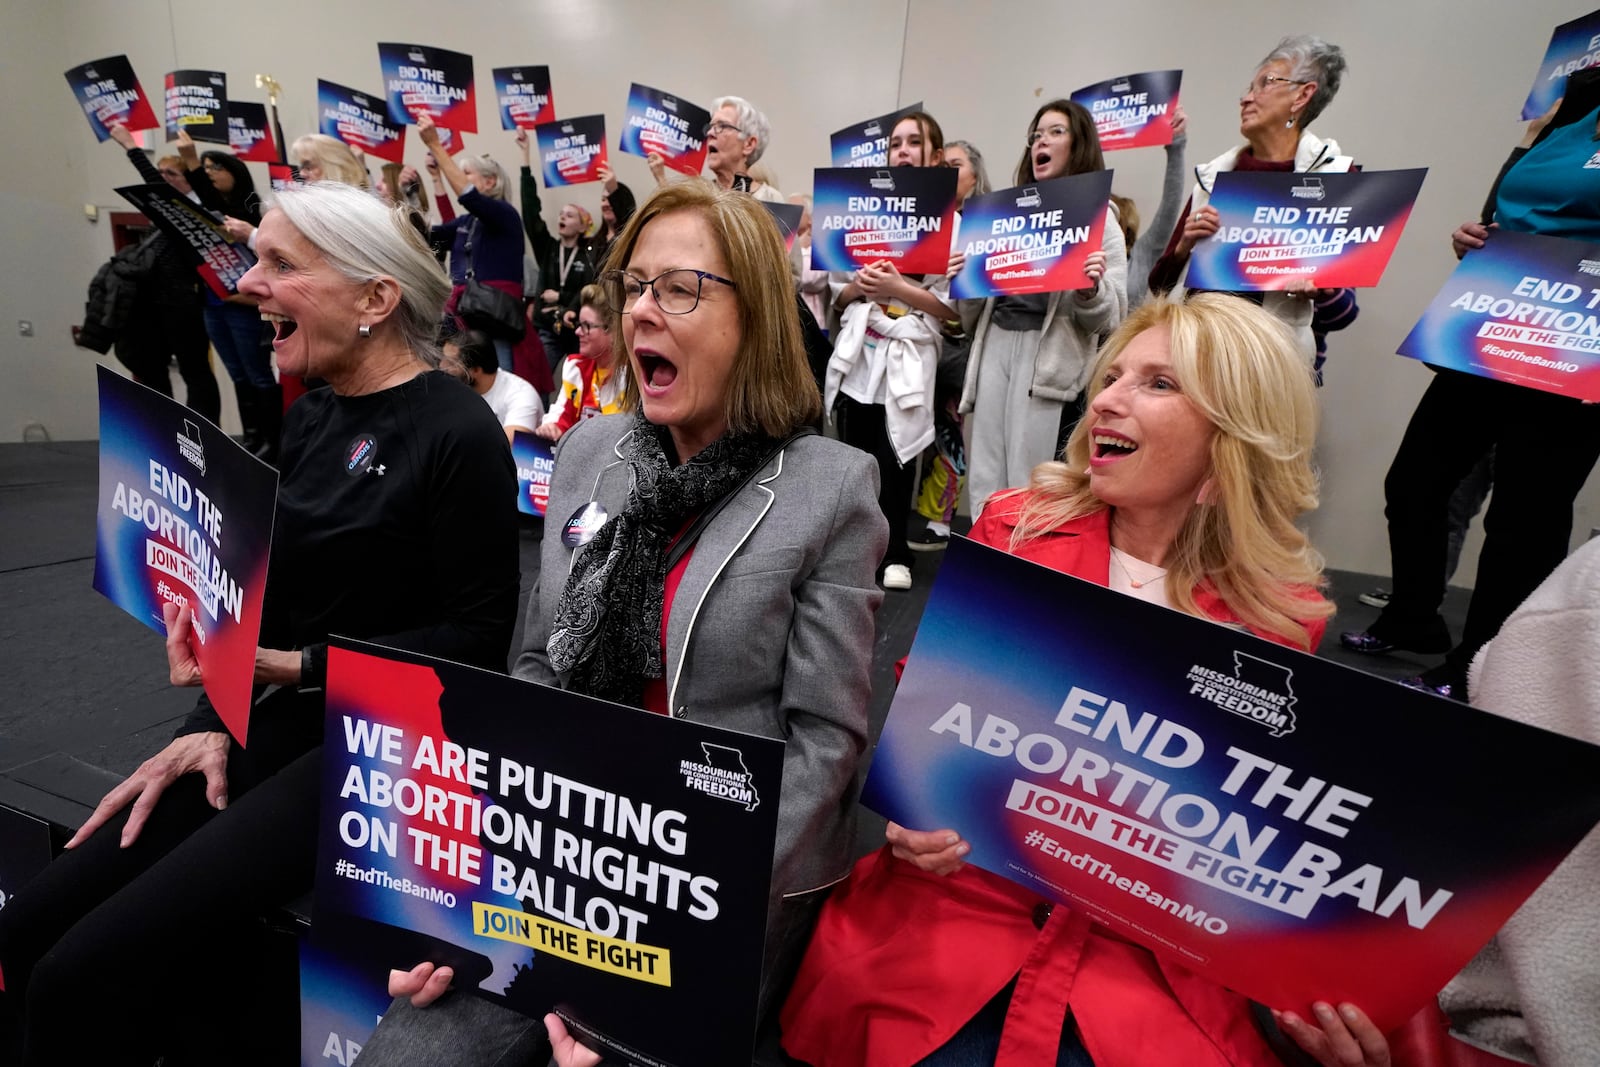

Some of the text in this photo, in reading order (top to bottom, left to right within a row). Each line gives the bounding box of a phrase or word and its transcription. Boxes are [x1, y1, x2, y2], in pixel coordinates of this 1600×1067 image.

[399, 66, 444, 82] END THE
[1548, 51, 1600, 80] ABOR
[389, 80, 466, 101] ABORTION BAN
[1093, 93, 1148, 111] END THE
[324, 108, 375, 132] ABORTION
[377, 126, 399, 140] BAN
[339, 101, 360, 116] END
[362, 108, 383, 124] THE
[646, 107, 689, 132] END THE
[1092, 104, 1167, 124] ORTION BAN
[570, 134, 586, 145] THE
[630, 116, 679, 139] ABORTION
[680, 133, 702, 151] BAN
[583, 144, 600, 155] BAN
[851, 136, 890, 158] END TH
[848, 197, 916, 212] END THE
[1253, 207, 1352, 224] END THE
[822, 216, 941, 232] ABORTION BAN
[992, 210, 1063, 235] END THE
[1212, 226, 1384, 244] ABORTION BAN
[849, 234, 867, 244] JOIN
[888, 231, 912, 240] FIGHT
[963, 226, 1090, 256] ABORTION BAN
[195, 234, 240, 280] BORTION
[990, 246, 1057, 267] JOIN THE FIGHT
[1244, 244, 1337, 260] JOIN THE FIGHT
[992, 269, 1046, 280] #EndTheBanMO
[1246, 266, 1316, 274] #EndTheBanMO
[1512, 276, 1582, 304] END
[1450, 292, 1600, 337] ABORTION
[1484, 326, 1600, 350] JOIN THE FIGH
[1481, 344, 1579, 373] #EndTheBanMO
[180, 445, 204, 466] FREEDOM
[518, 468, 551, 485] ABORT
[149, 458, 222, 548] END THE
[112, 482, 244, 625] ABORTION BAN
[152, 546, 215, 610] JOIN THE FIGHT
[1186, 673, 1281, 712] FOR CONSTITUTIONAL
[1190, 664, 1288, 706] MISSOURIANS
[1190, 682, 1288, 728] FREEDOM
[681, 760, 746, 782] MISSOURIANS
[1053, 686, 1374, 838] END THE
[342, 715, 687, 856] WE ARE PUTTING
[680, 768, 745, 789] FOR CONSTITUTIONAL
[686, 776, 752, 802] FREEDOM
[929, 702, 1454, 930] ABORTION BAN
[340, 764, 719, 922] ABORTION RIGHTS
[1019, 789, 1302, 906] JOIN THE FIGHT
[334, 858, 456, 908] #EndTheBanMO
[338, 810, 648, 944] ON THE BALLOT
[1023, 829, 1228, 936] #EndTheBanMO
[482, 910, 659, 976] JOIN THE FIGHT
